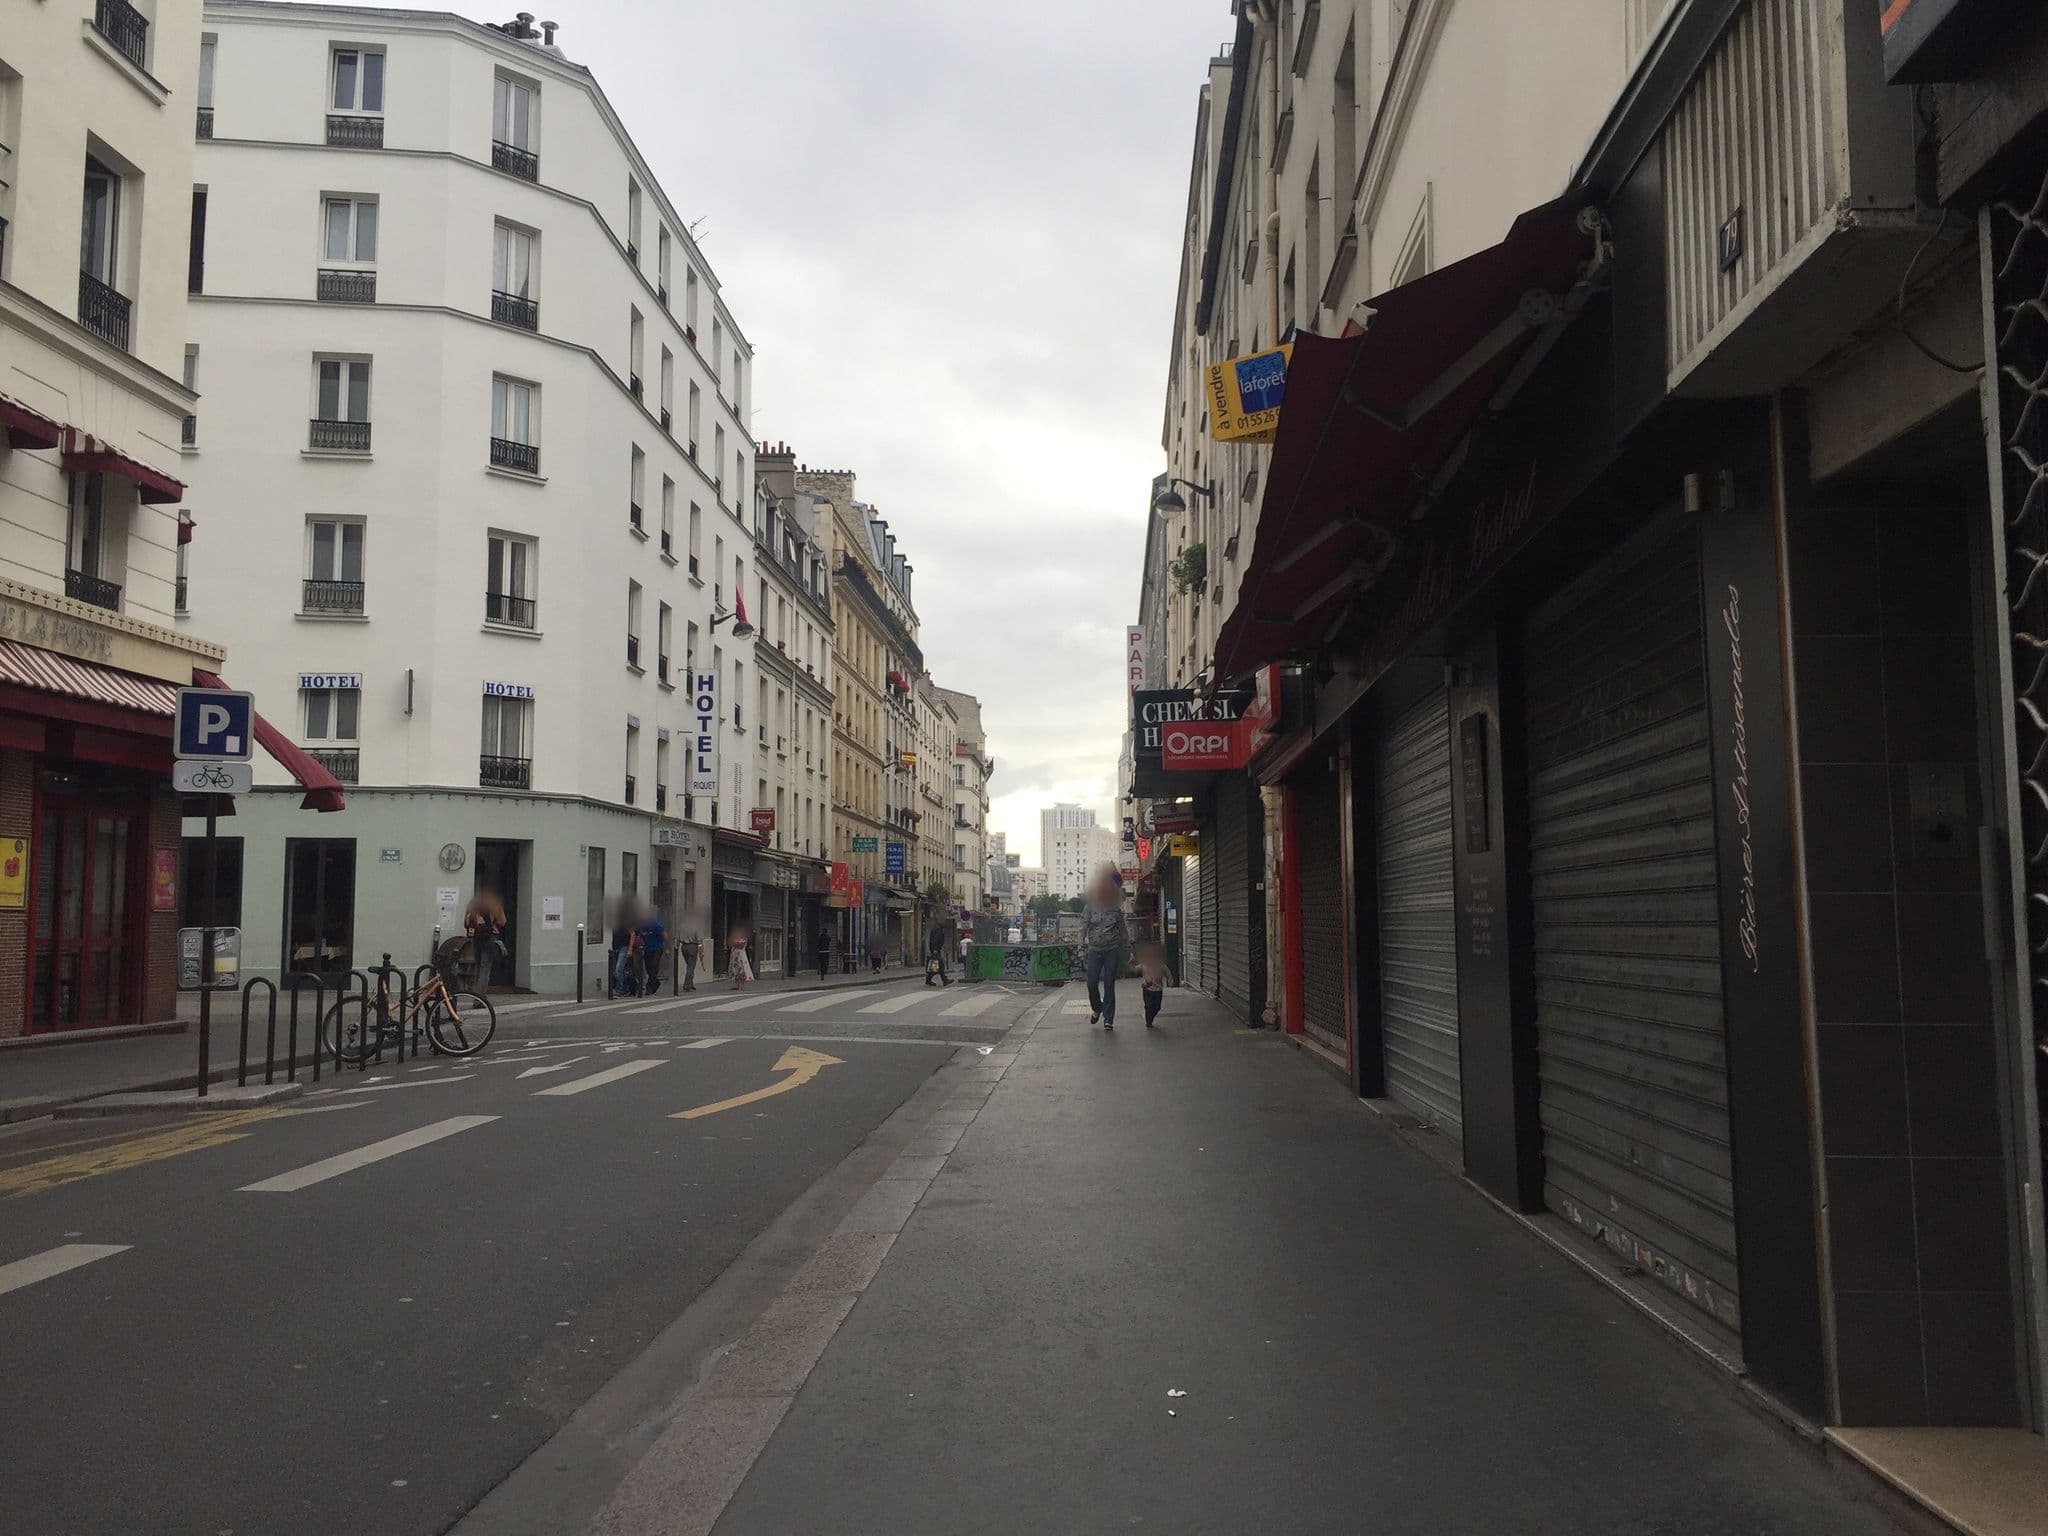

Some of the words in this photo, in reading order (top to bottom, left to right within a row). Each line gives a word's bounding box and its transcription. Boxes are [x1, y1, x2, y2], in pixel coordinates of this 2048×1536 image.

[1210, 366, 1228, 417] vendre
[1240, 371, 1286, 394] laforêt
[301, 676, 360, 688] HOTEL
[486, 682, 534, 698] HOTEL
[198, 704, 231, 745] P
[697, 675, 714, 773] HOTEL
[1167, 732, 1228, 754] ORPI
[693, 780, 716, 790] RIQUET
